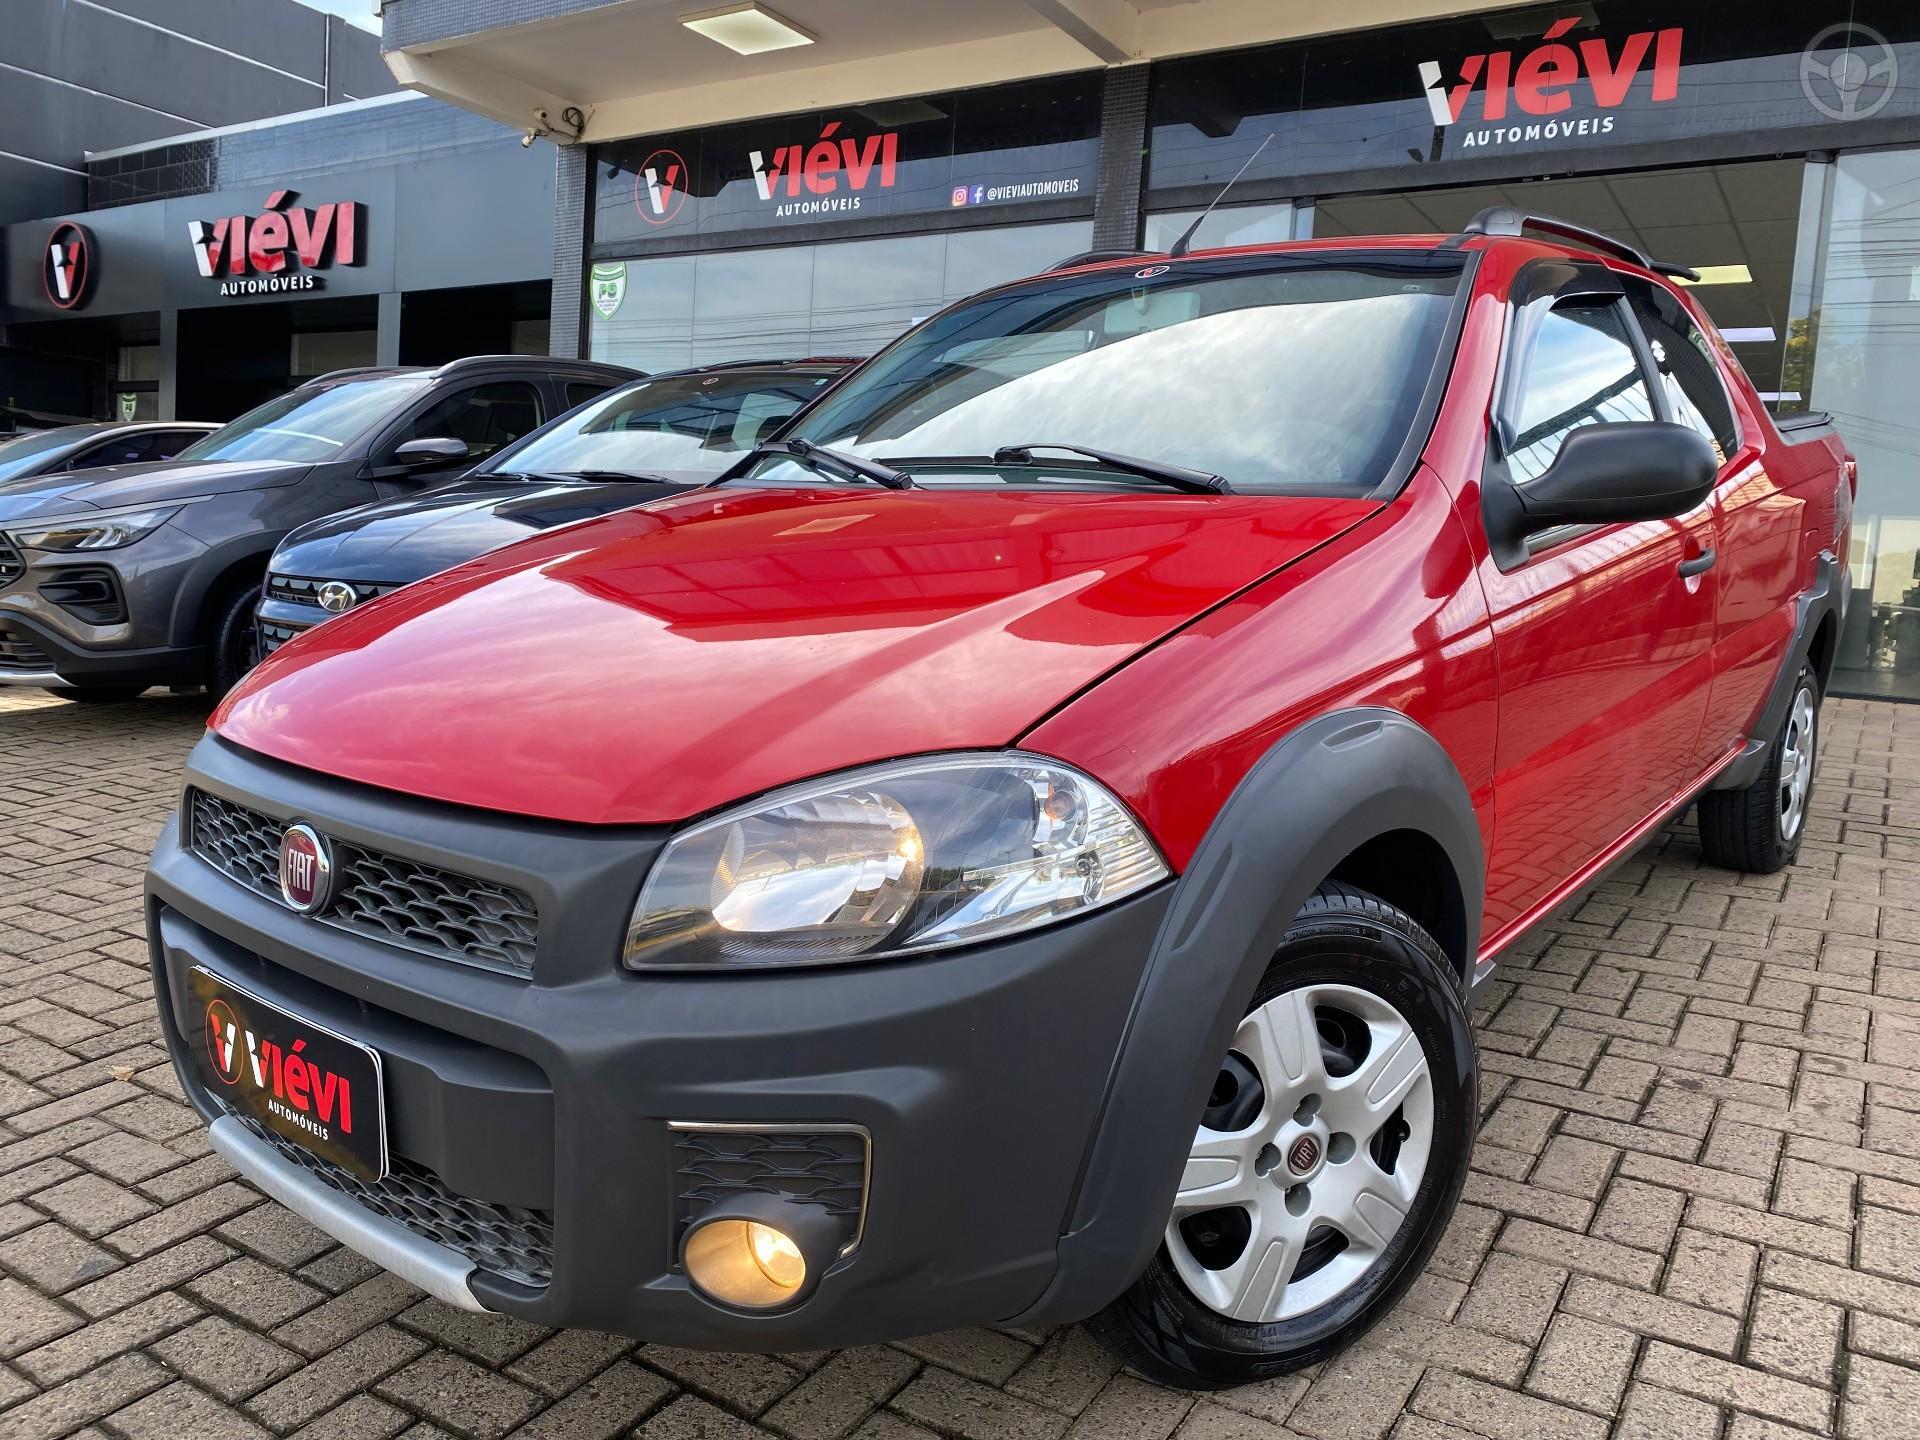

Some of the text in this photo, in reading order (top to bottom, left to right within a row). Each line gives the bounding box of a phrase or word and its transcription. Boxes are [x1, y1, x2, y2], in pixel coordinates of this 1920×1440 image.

[1463, 116, 1614, 147] AUTOMÓVEIS
[987, 179, 1079, 200] @VIEVIAUTOMOVEIS
[776, 196, 861, 217] AUTOMÓVEIS
[220, 274, 314, 296] AUTOMÓVEIS
[287, 847, 315, 892] FIAT
[268, 1098, 329, 1141] AUTOMÓVEIS
[1294, 1140, 1315, 1168] FIAT
